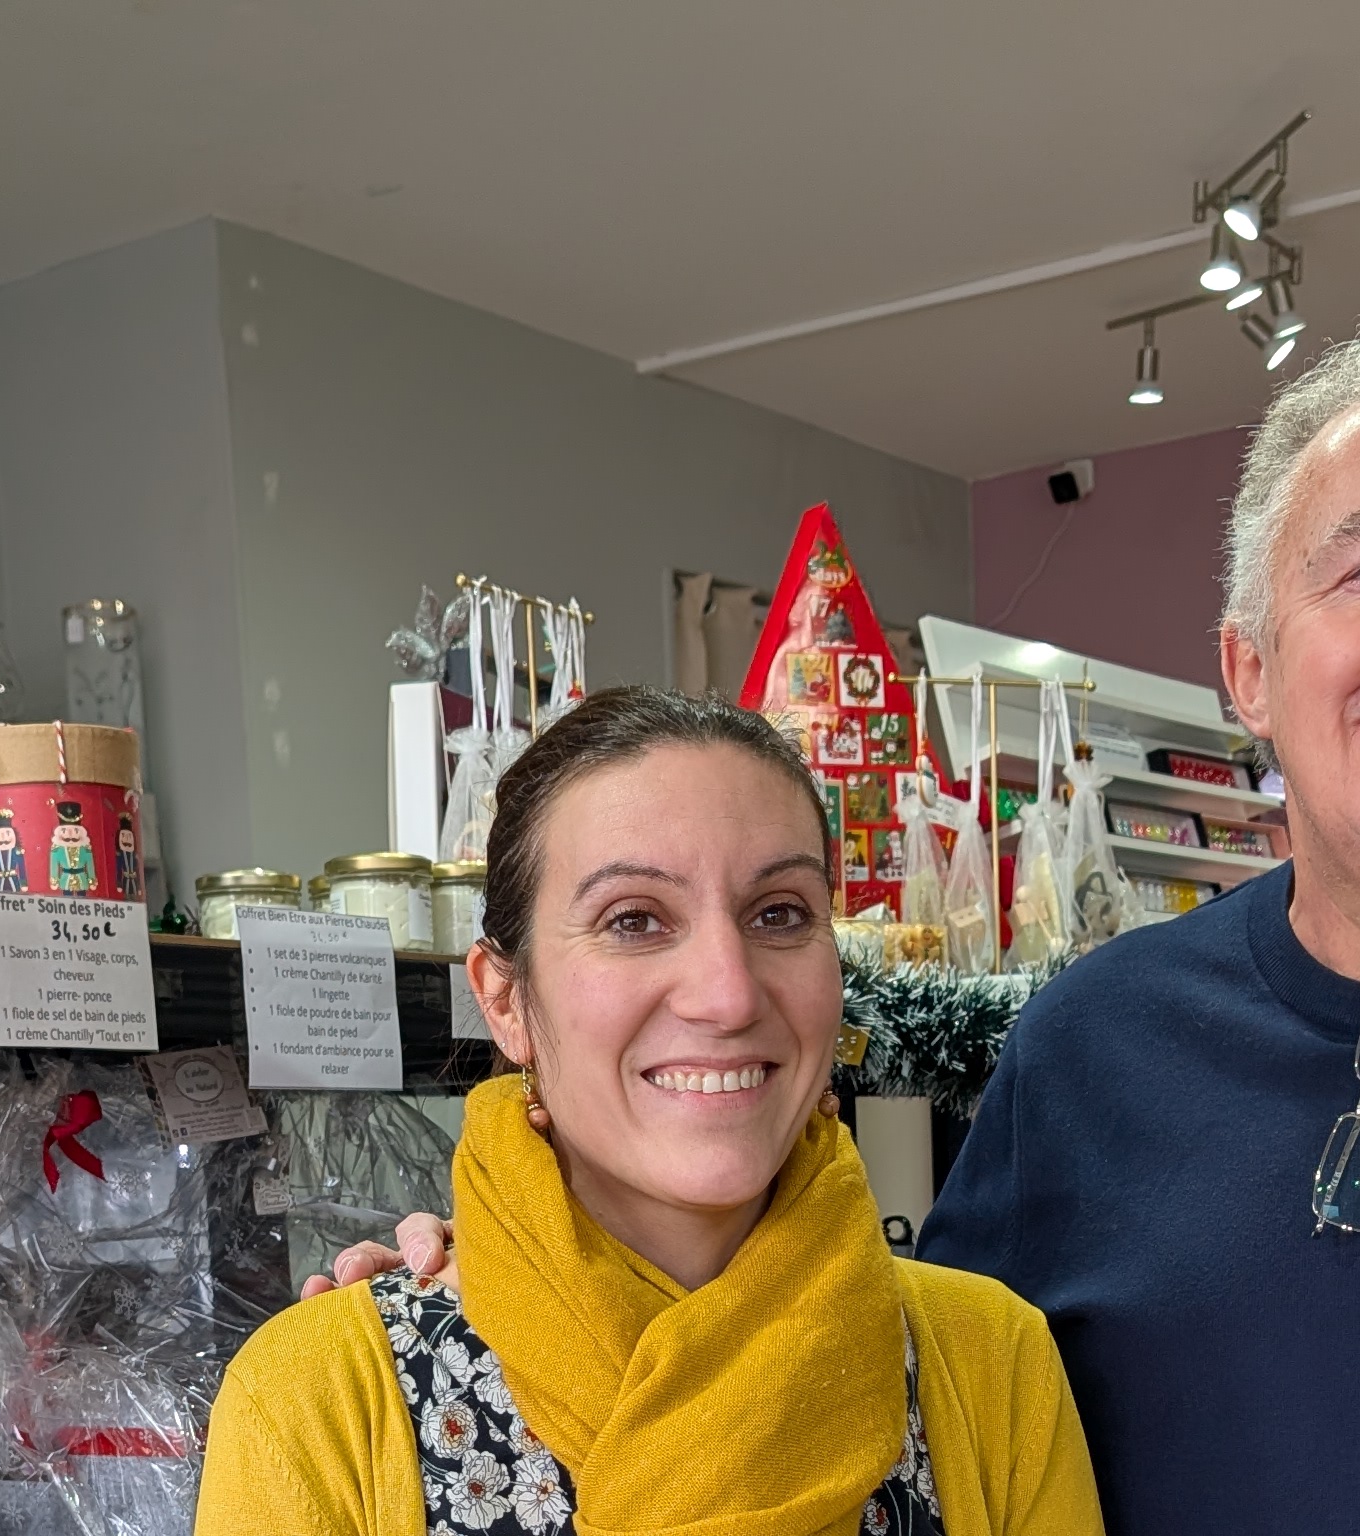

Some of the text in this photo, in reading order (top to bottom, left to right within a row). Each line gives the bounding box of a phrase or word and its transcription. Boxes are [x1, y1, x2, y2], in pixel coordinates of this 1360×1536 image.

[38, 899, 66, 914] Soin
[70, 901, 90, 916] des
[94, 903, 125, 919] Pieds
[236, 907, 389, 930] Coffret Bien Etre aux Pierres Chaudes
[2, 946, 139, 966] 1 Savon 3 en 1 Visage, corps,
[268, 948, 386, 968] 1 set de 3 pierres volcaniques
[54, 969, 94, 981] cheveux
[275, 967, 382, 984] 1 crème Chantilly de Karité
[39, 989, 112, 1004] 1 pierre- ponce
[7, 1029, 11, 1039] 1
[16, 1029, 48, 1040] crème
[51, 1029, 93, 1044] Chantilly
[123, 1032, 134, 1041] en
[321, 1064, 349, 1074] relaxer
